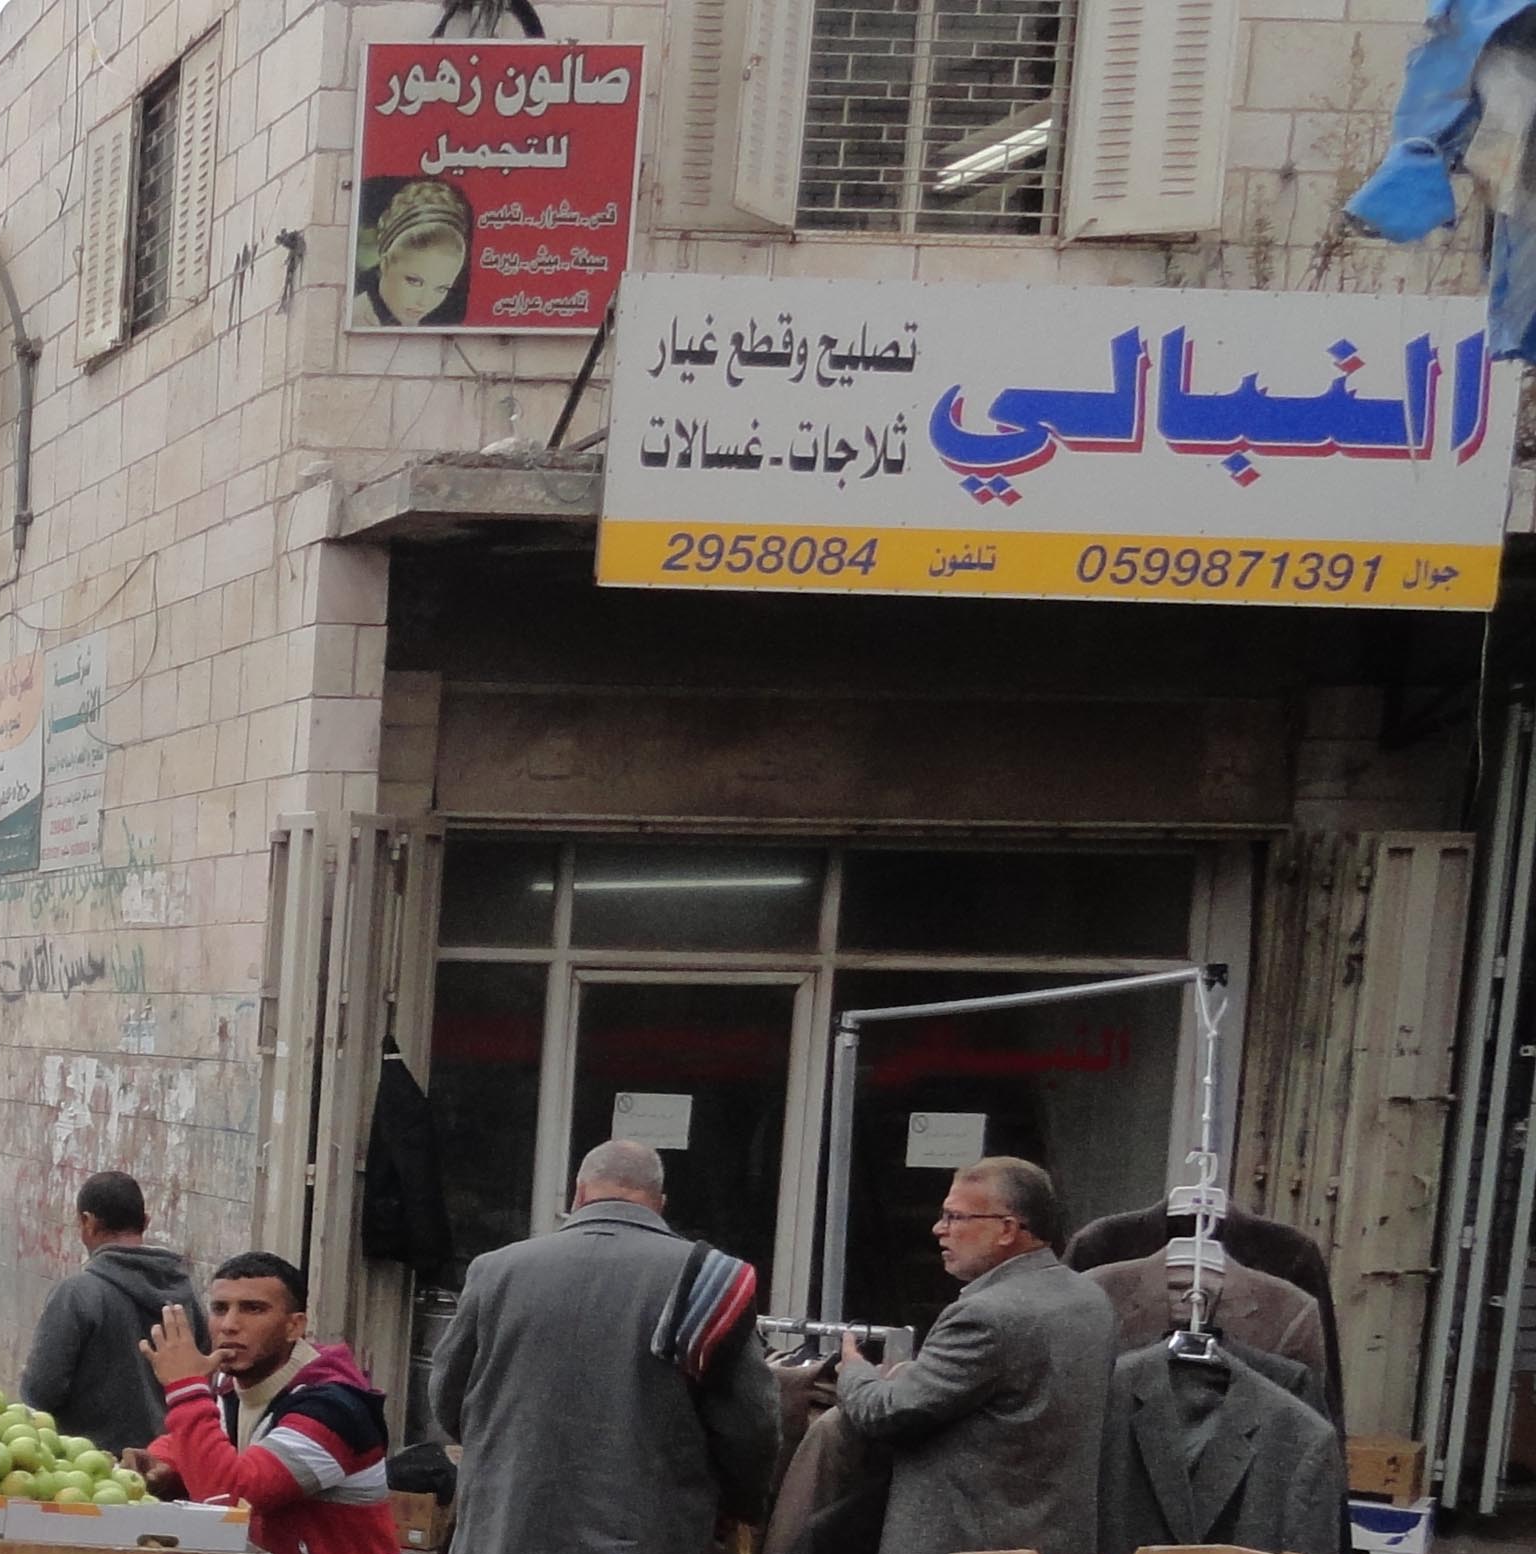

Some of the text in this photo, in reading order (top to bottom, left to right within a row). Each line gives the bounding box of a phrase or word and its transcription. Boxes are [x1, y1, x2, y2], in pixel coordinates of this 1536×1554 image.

[375, 53, 630, 117] صالون زهور
[420, 134, 569, 175] للتجميل
[646, 311, 919, 389] تصليح وقطع غيار
[928, 325, 1492, 508] النبالي
[661, 531, 1461, 594] جوال 0599871391 تلفون 2958084
